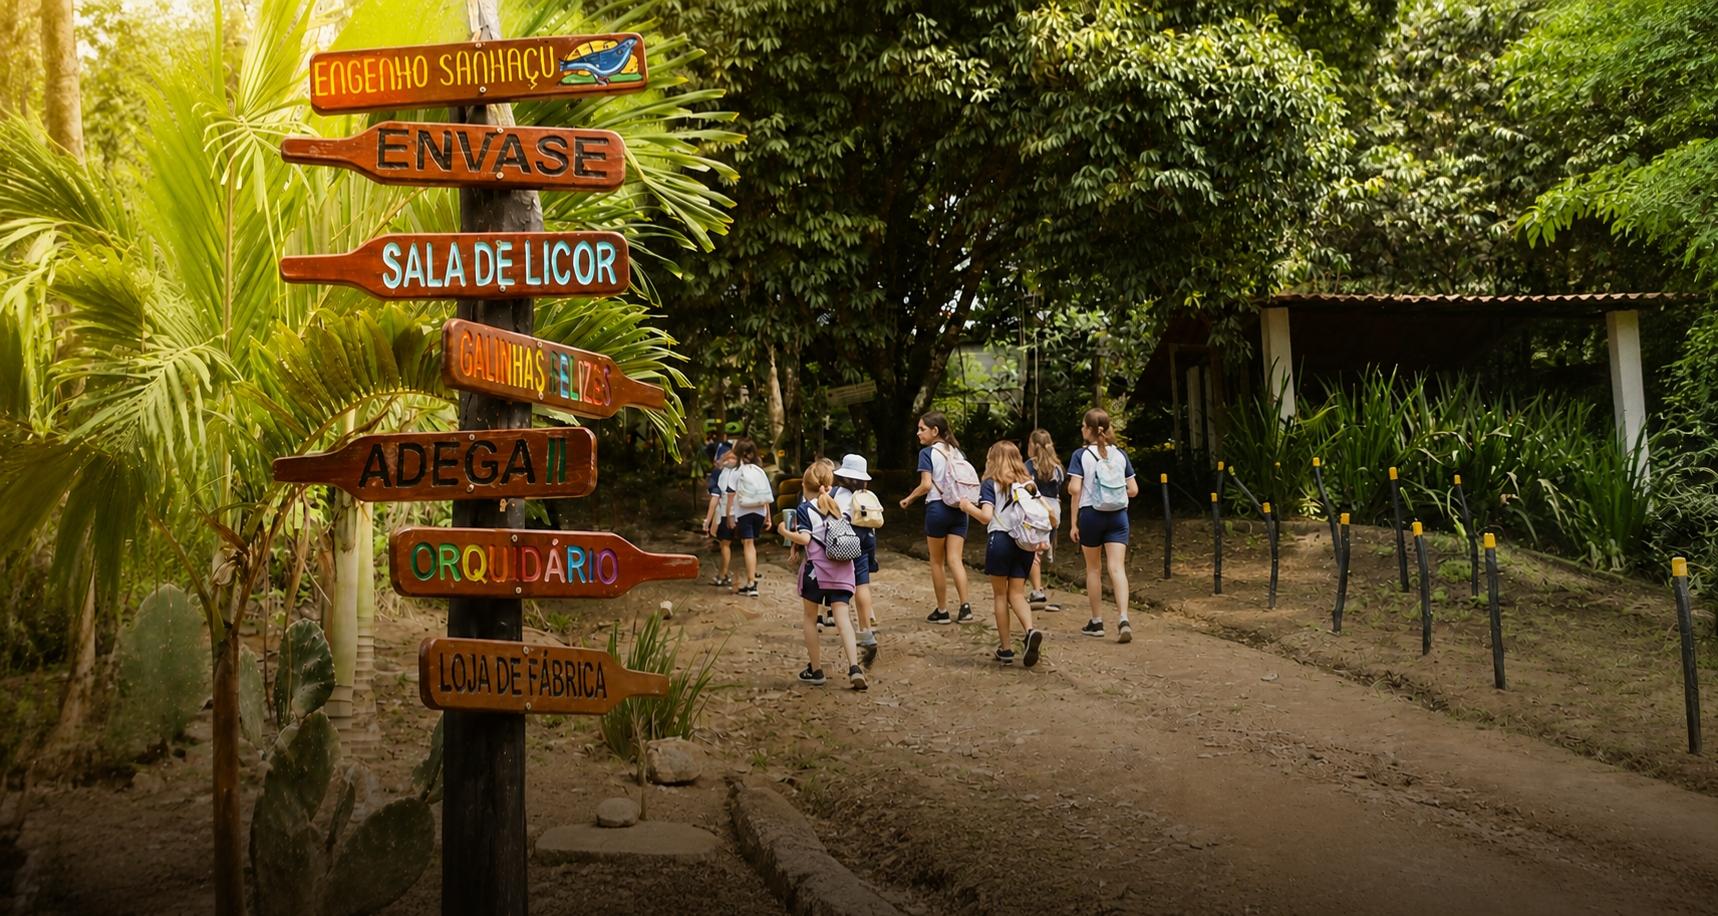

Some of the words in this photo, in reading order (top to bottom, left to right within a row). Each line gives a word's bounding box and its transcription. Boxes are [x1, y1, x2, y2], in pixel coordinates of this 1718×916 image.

[314, 54, 428, 97] ENGENHO
[439, 45, 555, 90] SANHAÇU
[376, 127, 611, 179] ENVASE
[382, 241, 466, 289] SALA
[474, 240, 516, 287] DE
[524, 239, 618, 286] LICOR
[460, 329, 546, 394] GALINHAS
[549, 350, 612, 407] FELIZES
[358, 438, 536, 489] ADEGA
[545, 437, 568, 486] II
[410, 538, 619, 585] ORQUIDÁRIO
[438, 652, 492, 694] LOJA
[496, 656, 523, 696] DE
[528, 650, 608, 699] FÁBRICA
